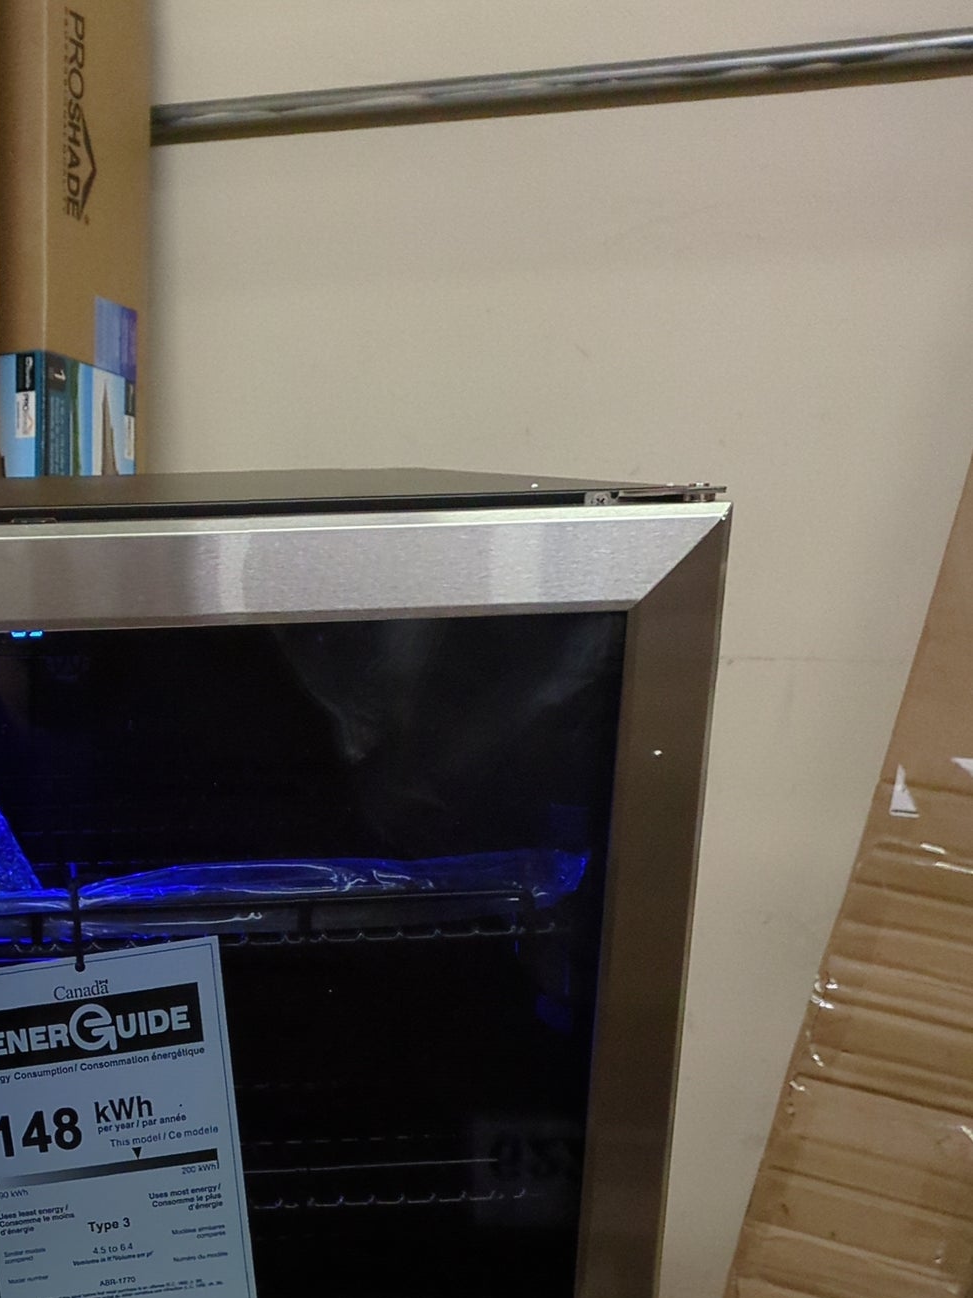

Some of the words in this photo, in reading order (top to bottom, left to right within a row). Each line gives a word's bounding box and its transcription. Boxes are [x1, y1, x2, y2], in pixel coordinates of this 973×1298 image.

[66, 9, 85, 221] PROSHADE
[53, 978, 110, 1001] Canada
[80, 1053, 150, 1071] Consommation
[151, 1046, 206, 1062] énergétique
[94, 1095, 154, 1125] kWh
[98, 1124, 112, 1135] per
[114, 1121, 135, 1133] year
[142, 1117, 157, 1129] par
[159, 1112, 187, 1126] année
[110, 1136, 130, 1149] This
[132, 1132, 162, 1146] model
[168, 1129, 182, 1141] Ce
[148, 1191, 168, 1200] Uses
[170, 1188, 189, 1196] most
[88, 1220, 119, 1234] Type
[123, 1217, 131, 1228] 3
[108, 1244, 118, 1253] to
